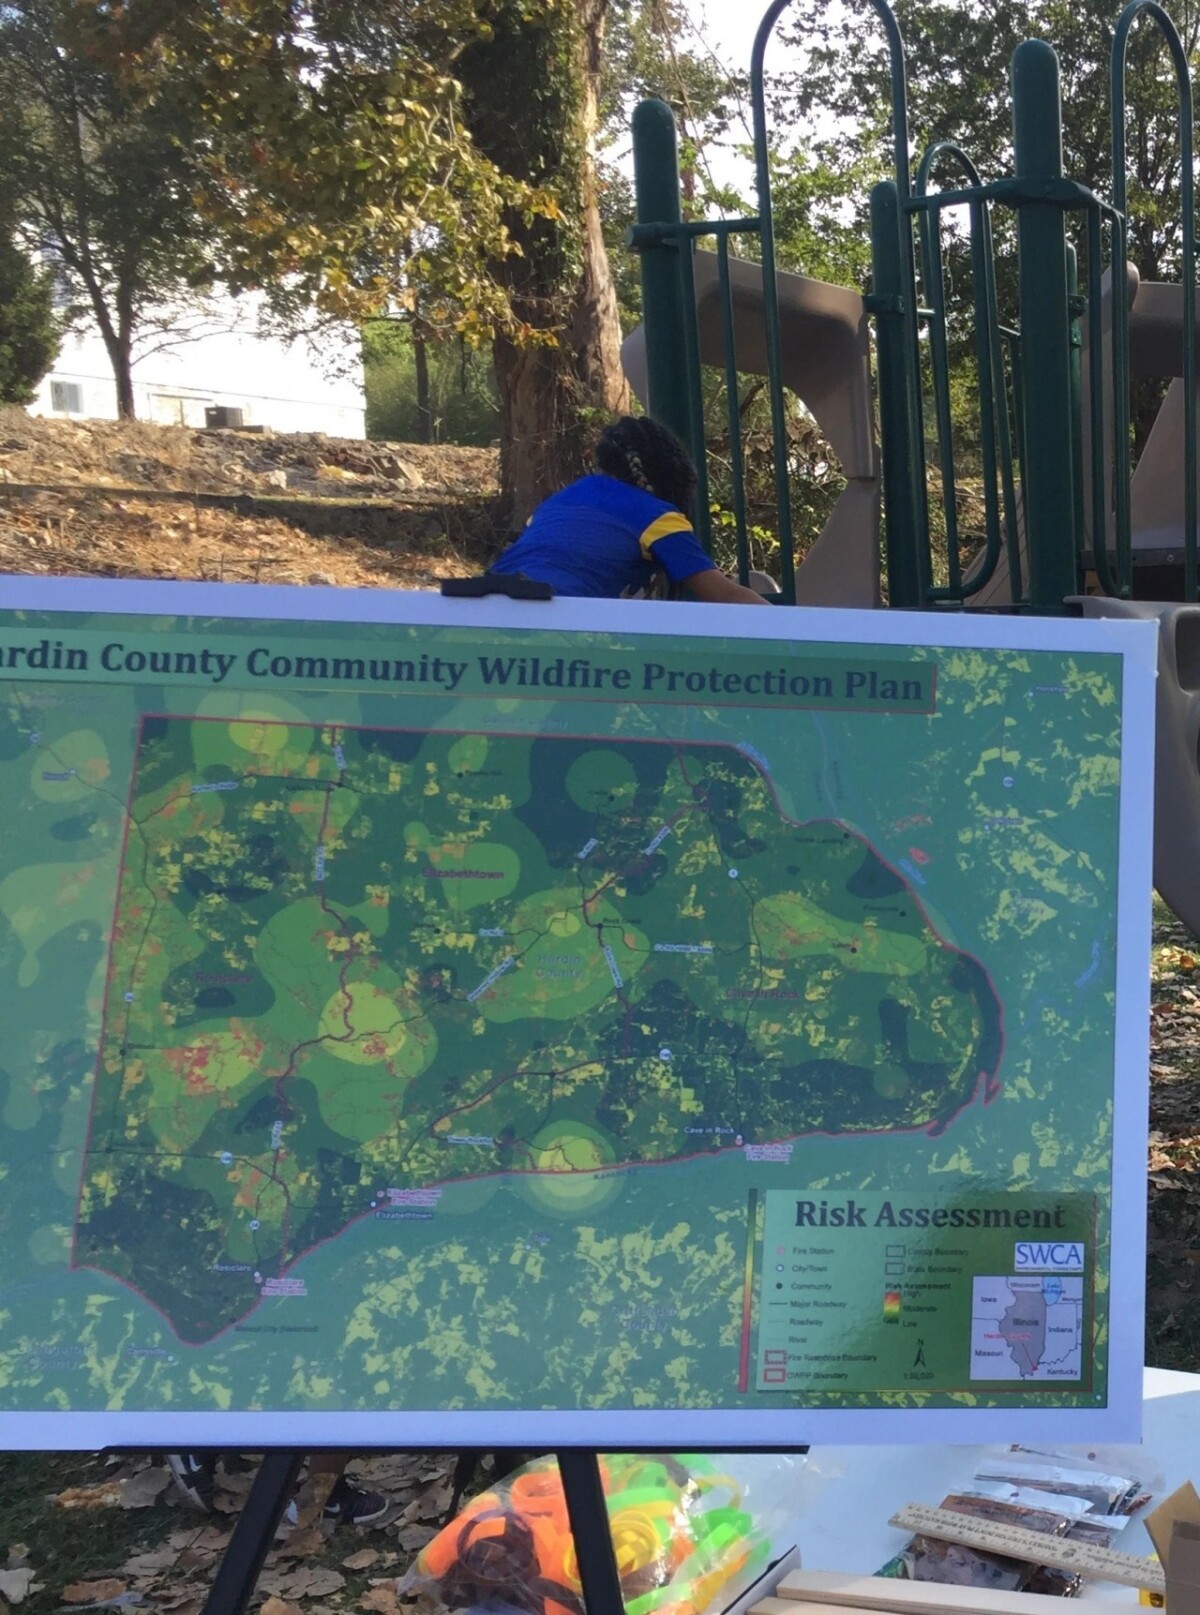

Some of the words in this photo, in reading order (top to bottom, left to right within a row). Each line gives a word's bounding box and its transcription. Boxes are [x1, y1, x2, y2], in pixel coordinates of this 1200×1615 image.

[0, 639, 89, 671] rdin
[100, 643, 237, 683] County
[246, 648, 468, 690] Community
[477, 656, 632, 690] Wildfire
[642, 662, 834, 698] Protection
[844, 671, 923, 701] Plan
[422, 867, 505, 880] Elizabethtown
[683, 1126, 703, 1134] Cave
[376, 1211, 434, 1220] Elizabethtown
[794, 1199, 867, 1227] Risk
[873, 1200, 1067, 1229] Assessment
[1016, 1243, 1082, 1265] SWCA
[1048, 1326, 1074, 1334] Indiana
[1047, 1367, 1078, 1377] Kentucky
